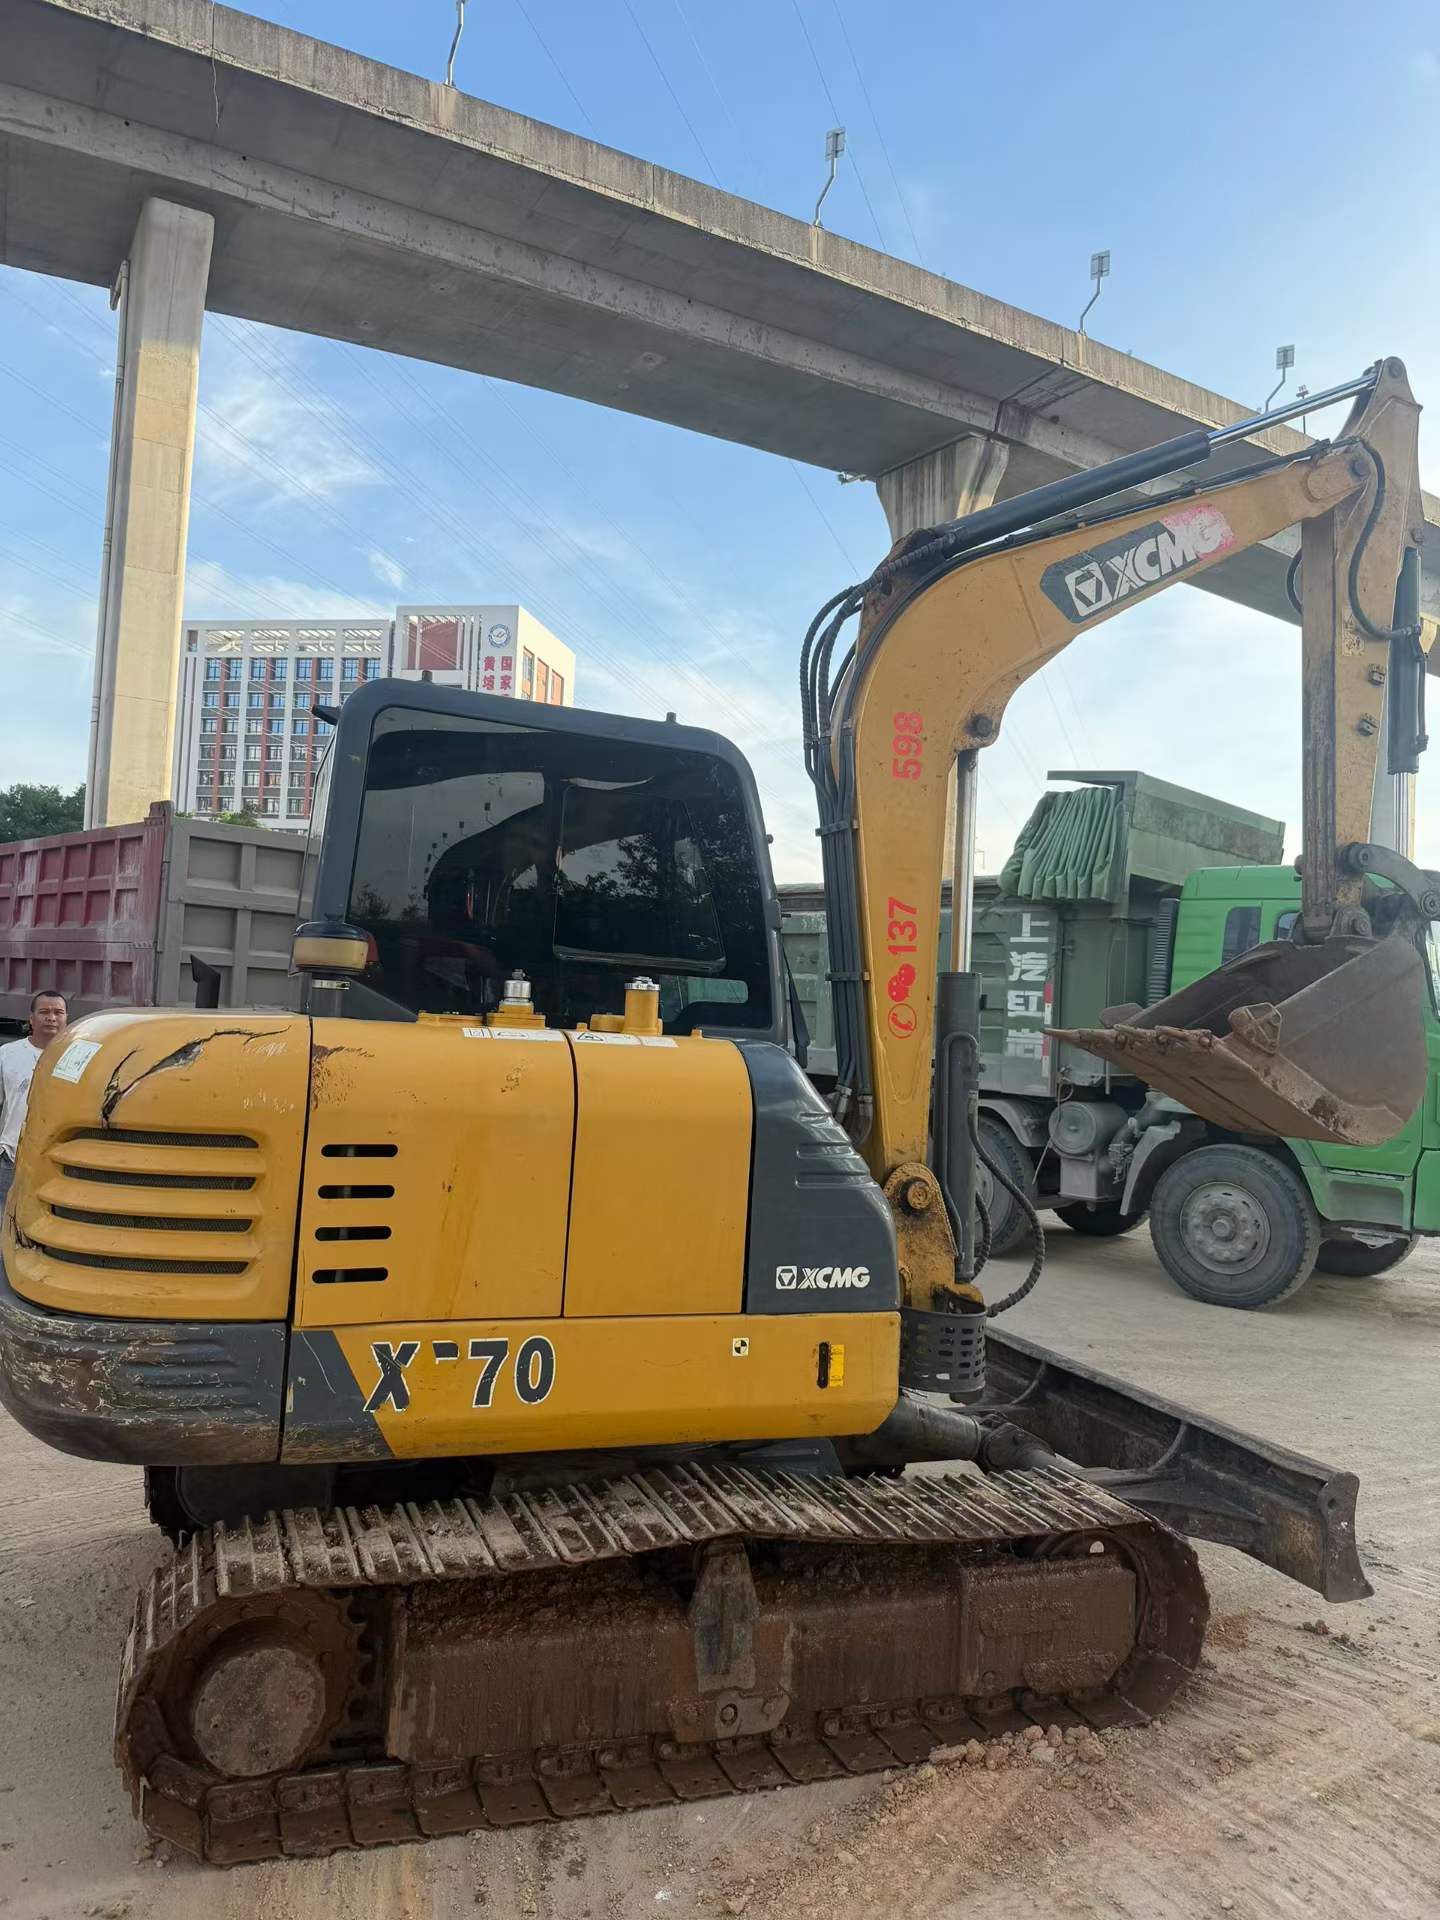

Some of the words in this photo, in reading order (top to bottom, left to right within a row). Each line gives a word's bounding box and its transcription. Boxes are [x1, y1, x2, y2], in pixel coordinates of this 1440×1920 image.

[1102, 512, 1222, 600] XCMG
[500, 656, 512, 696] 国家
[892, 711, 924, 780] 598
[888, 897, 918, 956] 137
[798, 1266, 871, 1289] XCMG
